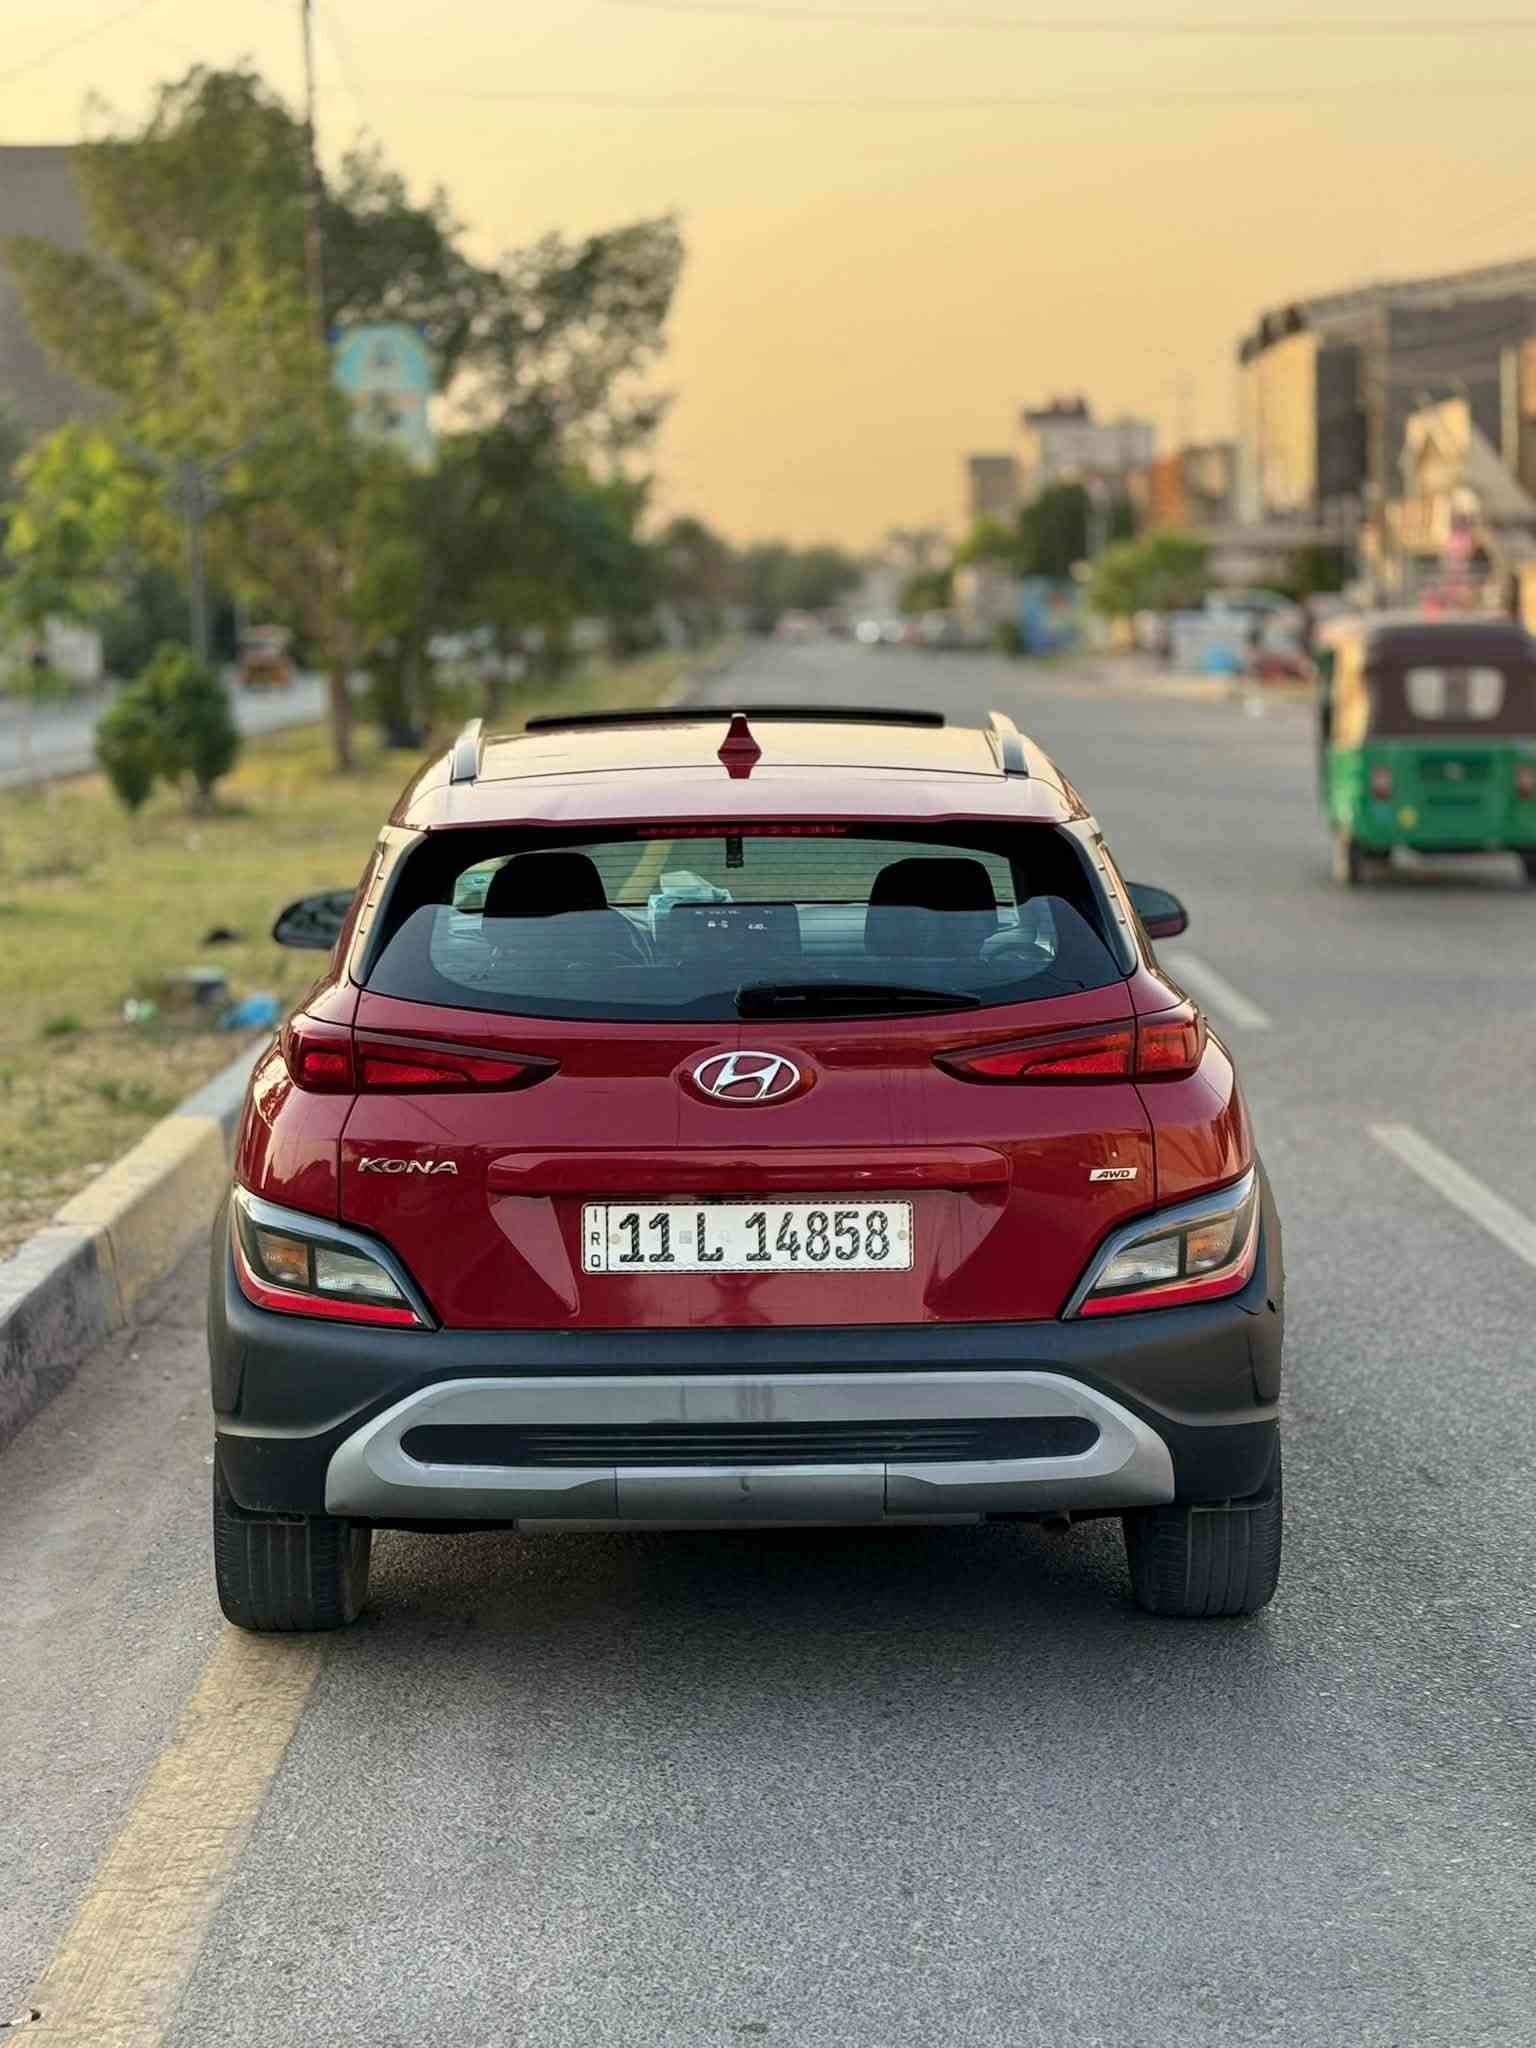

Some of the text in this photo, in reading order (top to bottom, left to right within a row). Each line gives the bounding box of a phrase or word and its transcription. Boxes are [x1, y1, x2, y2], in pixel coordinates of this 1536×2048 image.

[358, 1157, 459, 1175] KONA
[1096, 1170, 1130, 1178] AWD
[619, 1210, 890, 1262] 11 L 14858
